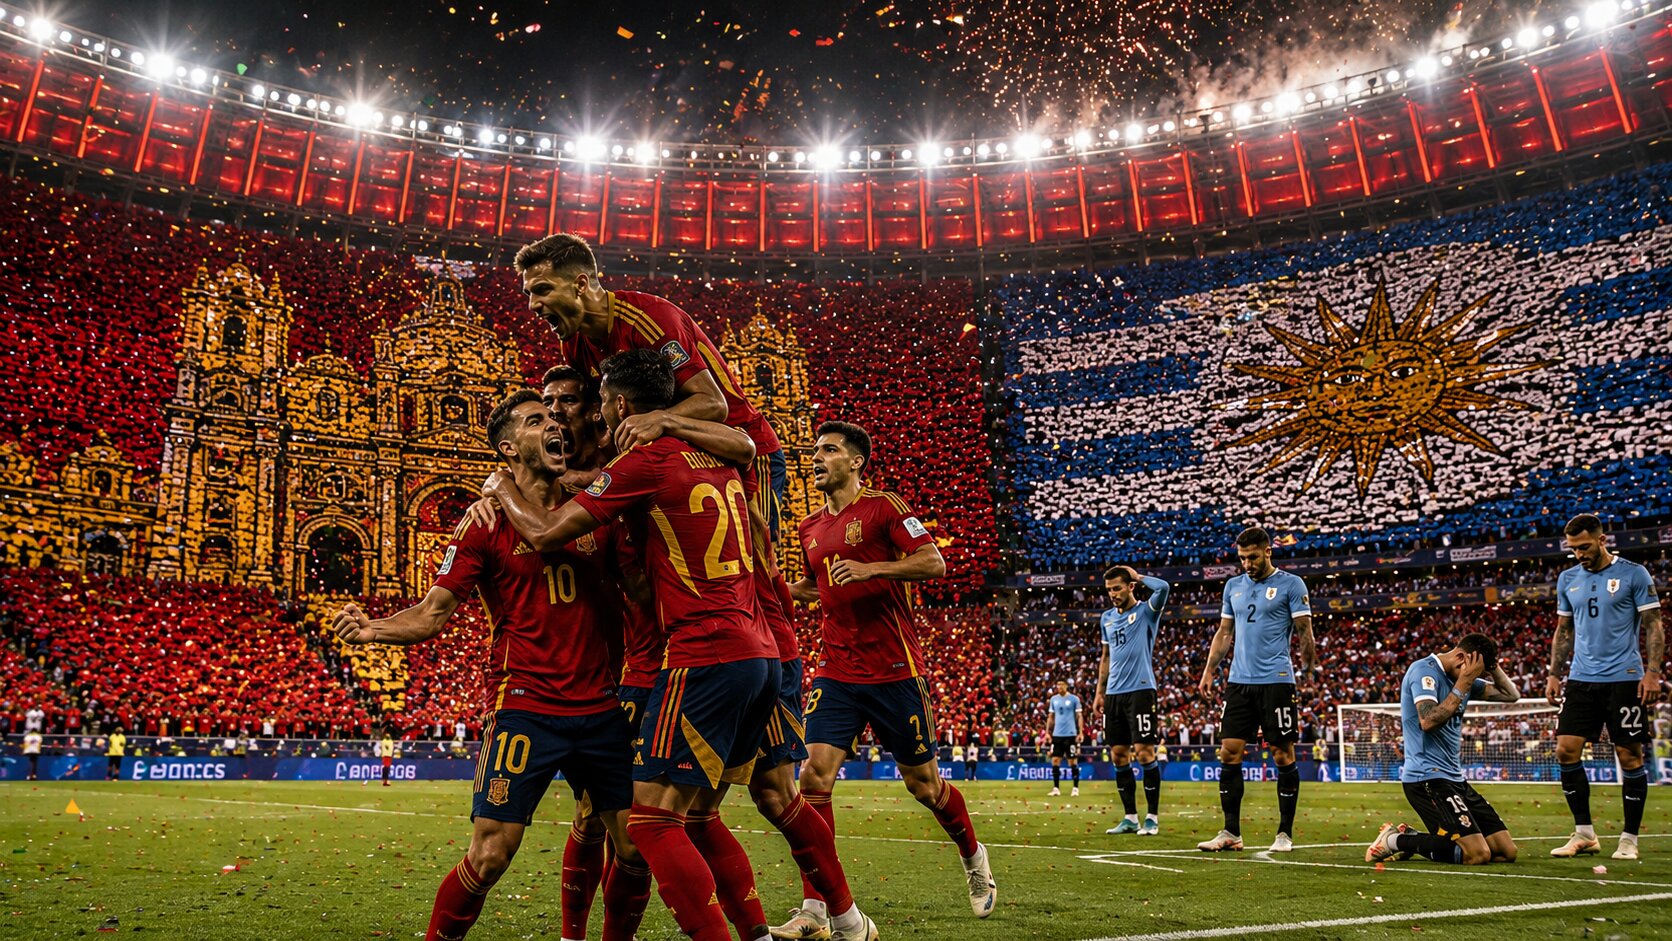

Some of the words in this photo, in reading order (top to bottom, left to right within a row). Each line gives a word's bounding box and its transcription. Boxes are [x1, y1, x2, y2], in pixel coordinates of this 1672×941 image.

[688, 479, 754, 580] 20
[543, 563, 577, 605] 10
[1247, 604, 1256, 623] 2
[1588, 597, 1599, 619] 6
[1114, 628, 1127, 647] 15
[1136, 714, 1151, 732] 15
[1274, 707, 1292, 729] 15
[1619, 706, 1643, 728] 22
[493, 731, 532, 775] 10
